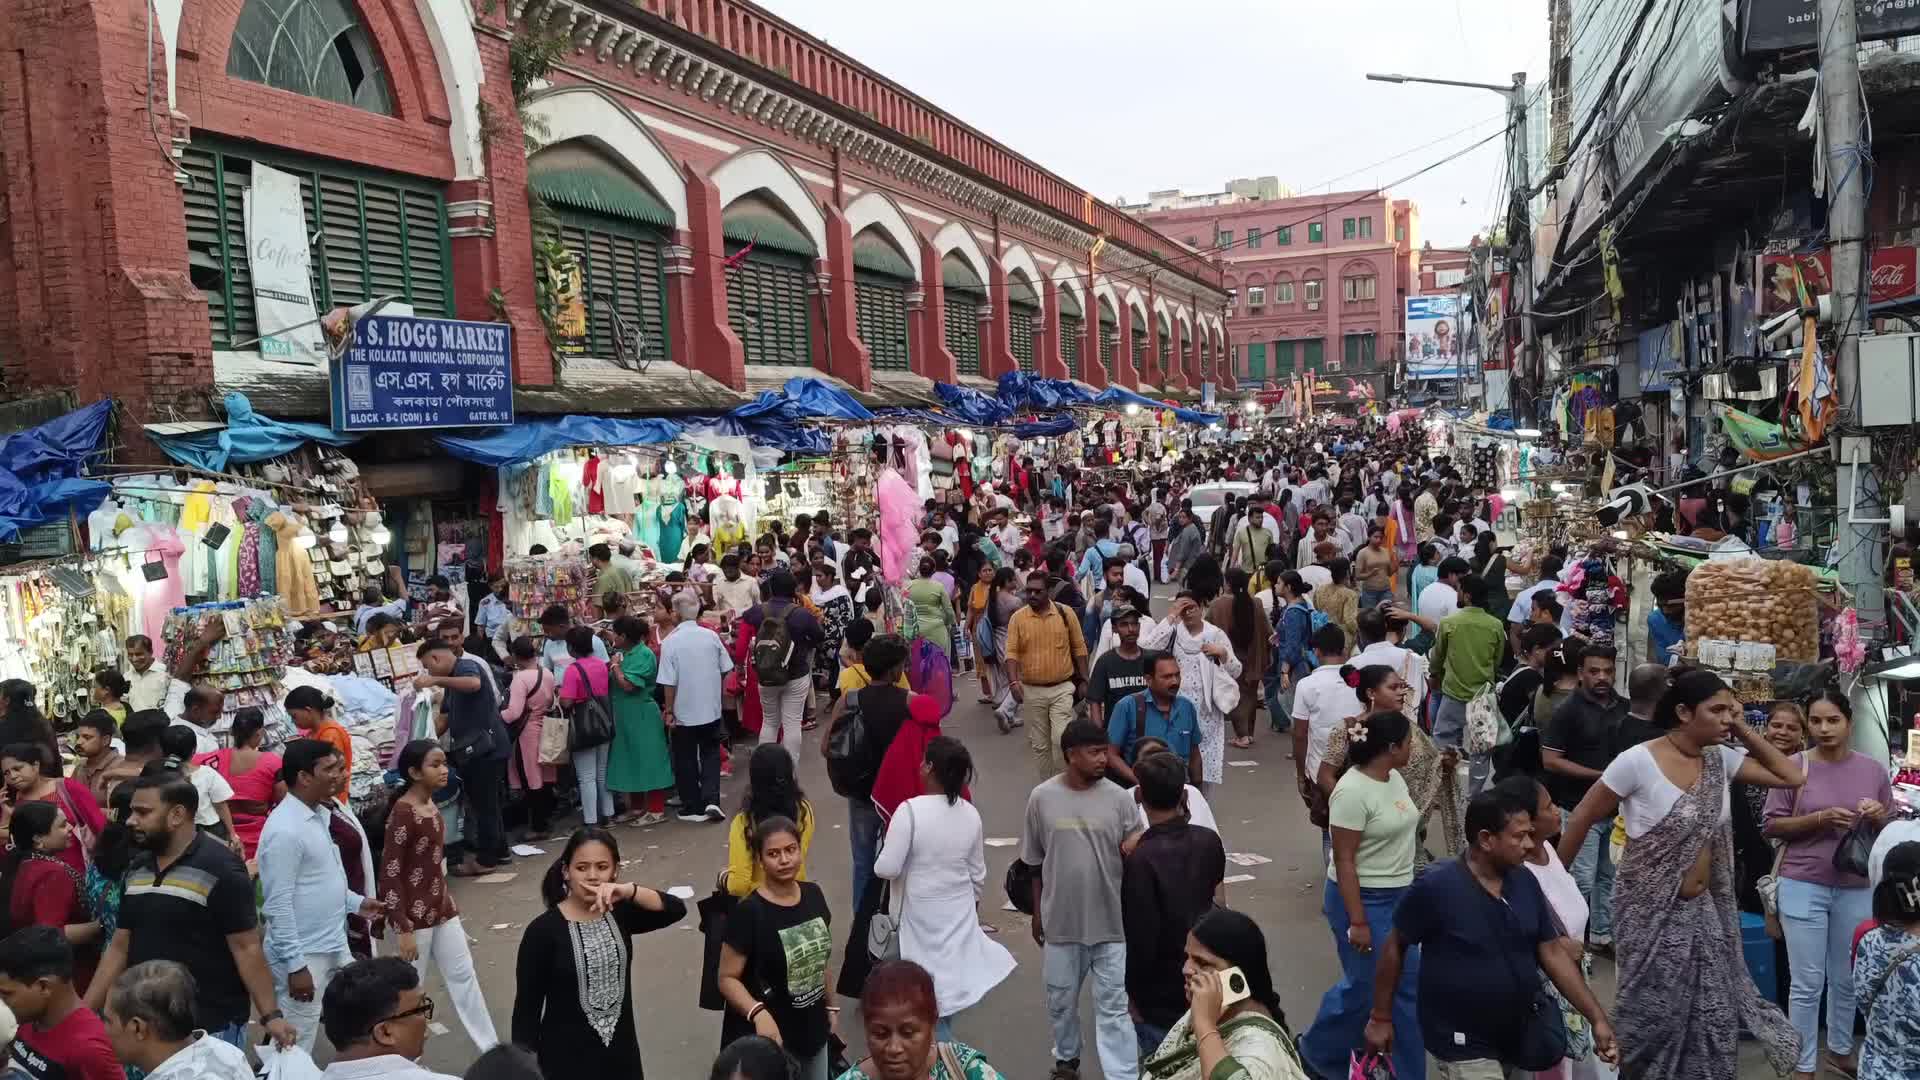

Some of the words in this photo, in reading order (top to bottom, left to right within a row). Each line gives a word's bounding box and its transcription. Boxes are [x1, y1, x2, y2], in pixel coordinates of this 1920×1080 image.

[367, 319, 383, 345] S.
[387, 321, 437, 349] HOGG
[441, 324, 505, 351] MARKET
[350, 349, 366, 361] THE
[368, 350, 407, 363] KOLKATA
[410, 351, 454, 364] MUNICIPAL
[457, 352, 505, 366] CORPORATION
[440, 372, 461, 391] হগ
[465, 367, 506, 391] মার্কেট
[392, 396, 443, 408] কলকাতা
[446, 394, 496, 408] পৌরসংস্থা
[351, 413, 379, 423] BLOCK
[400, 412, 422, 424] (CON)
[469, 411, 487, 421] GATE
[488, 411, 500, 421] NO.
